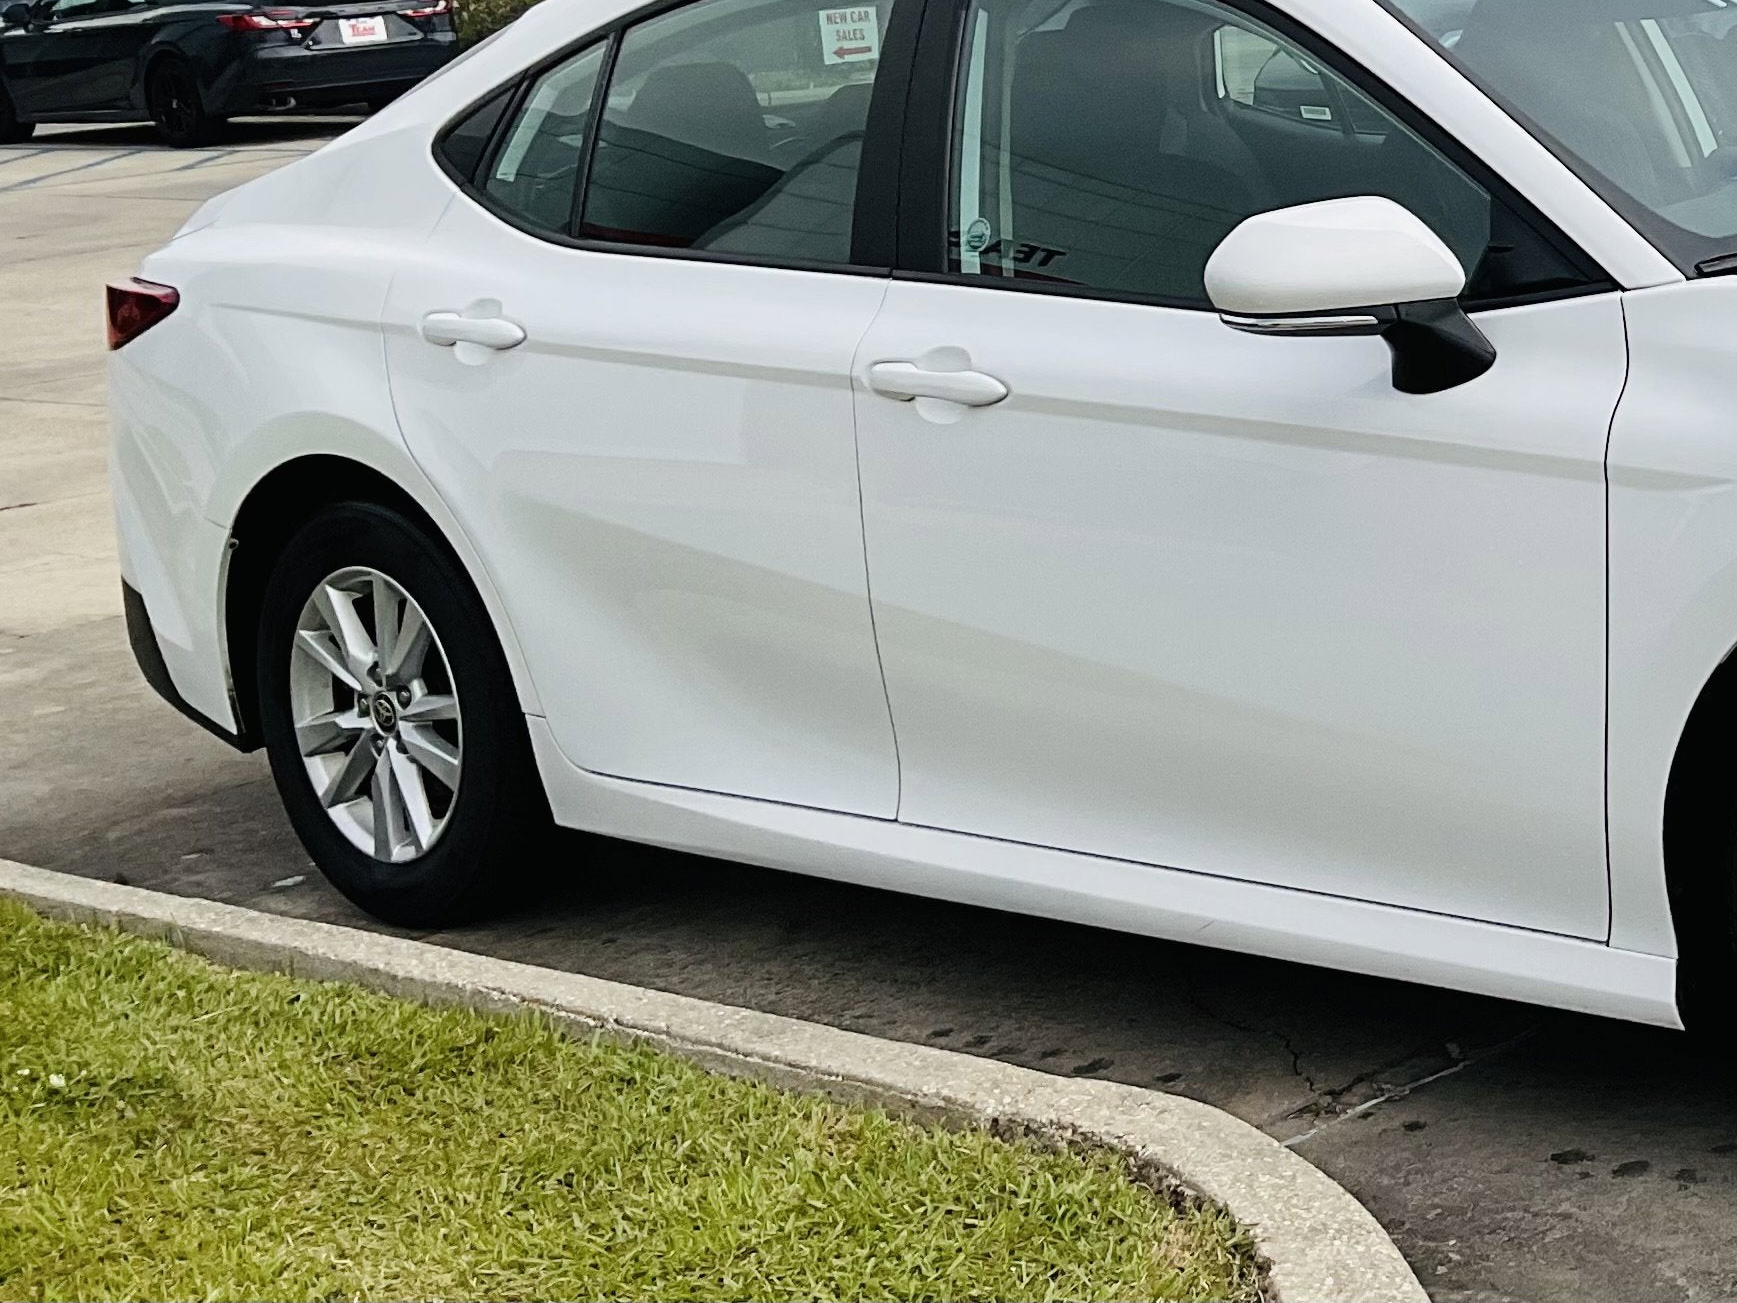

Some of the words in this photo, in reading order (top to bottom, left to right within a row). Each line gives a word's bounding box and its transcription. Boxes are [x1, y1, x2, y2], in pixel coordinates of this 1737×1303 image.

[826, 11, 847, 25] NEW
[850, 10, 871, 24] CAR
[835, 28, 865, 42] SALES
